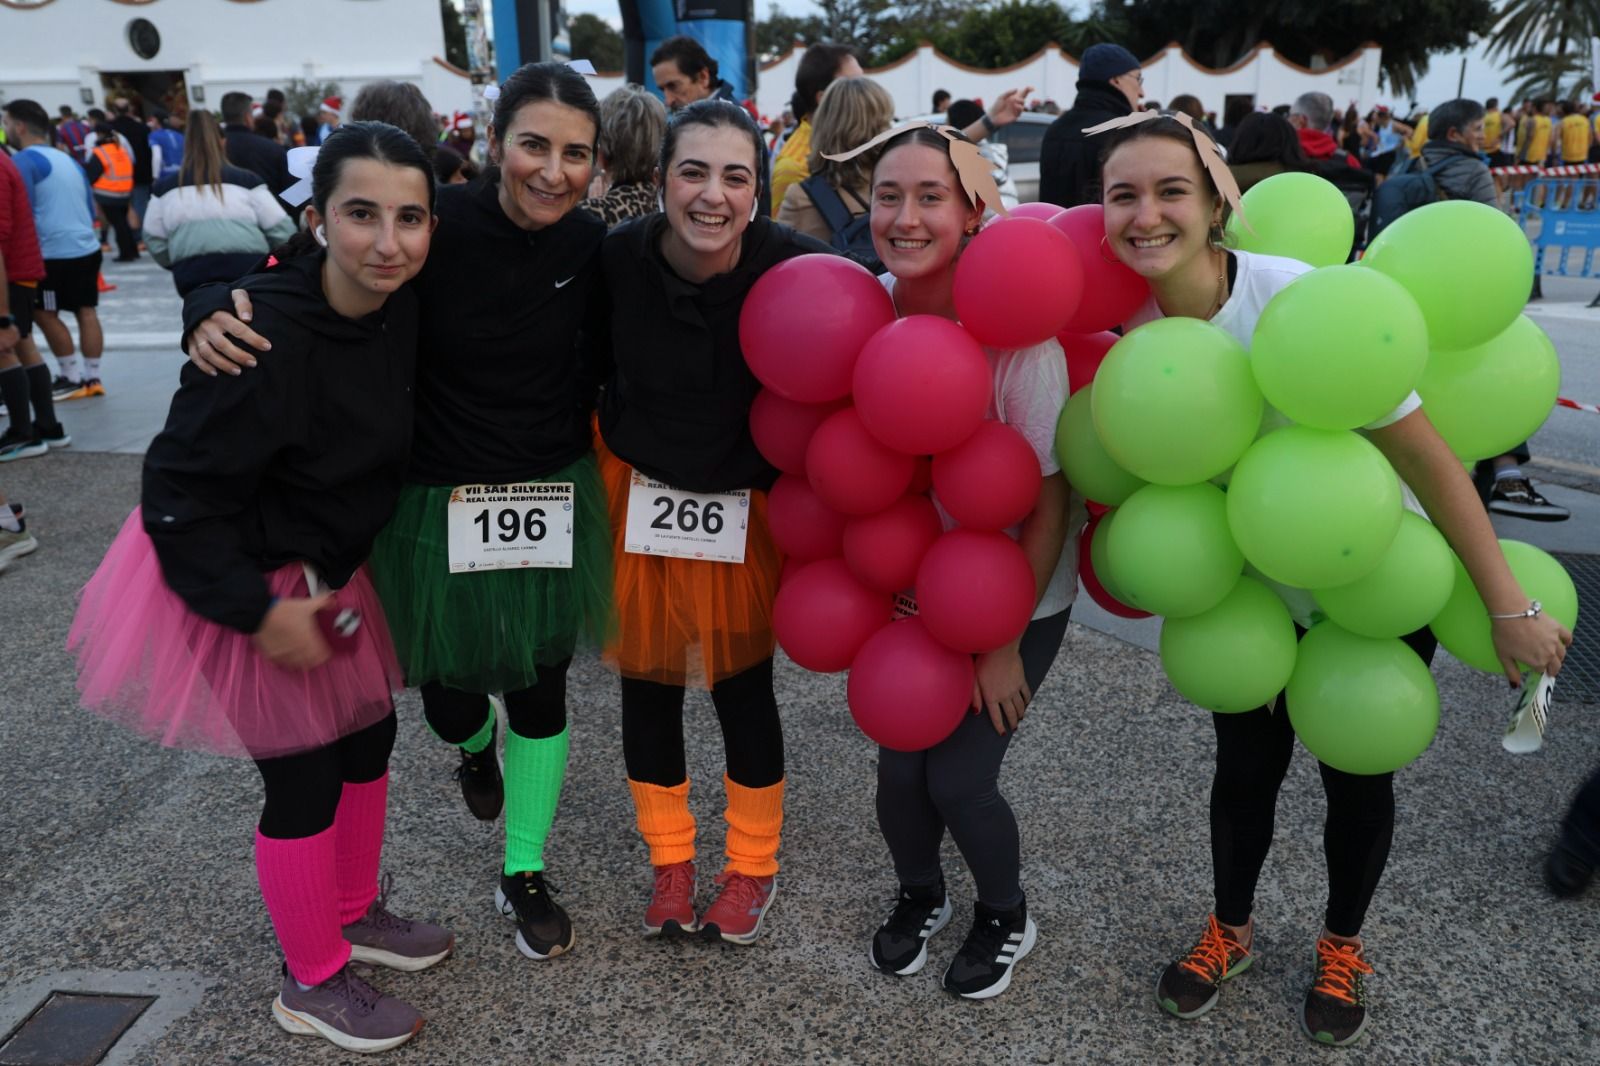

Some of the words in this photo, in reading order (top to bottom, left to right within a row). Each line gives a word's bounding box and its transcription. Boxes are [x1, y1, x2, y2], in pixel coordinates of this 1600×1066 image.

[465, 486, 481, 495] VII
[484, 485, 508, 494] SAN
[511, 485, 572, 494] SILVESTRE
[647, 482, 668, 490] REAL
[474, 508, 547, 543] 196
[650, 496, 724, 535] 266
